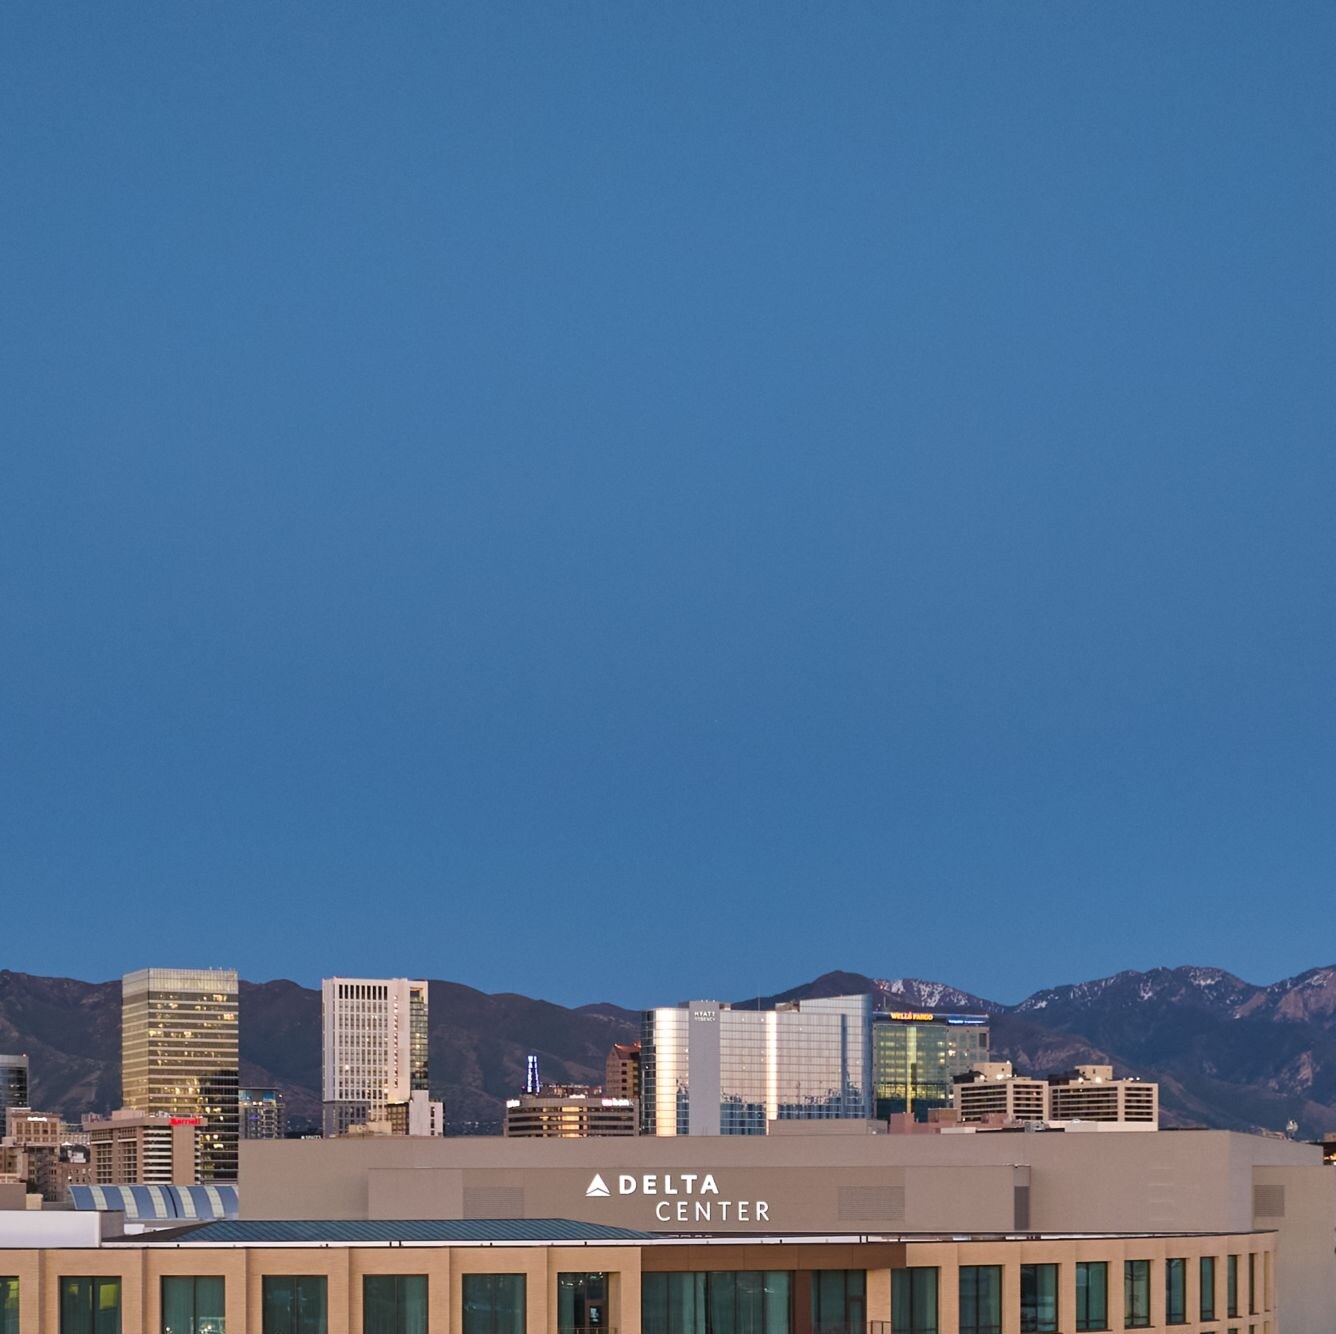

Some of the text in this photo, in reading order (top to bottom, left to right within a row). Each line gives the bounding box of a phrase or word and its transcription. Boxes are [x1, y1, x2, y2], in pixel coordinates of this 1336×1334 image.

[890, 1011, 934, 1021] WELLS FARGO
[618, 1174, 719, 1195] DELTA
[655, 1201, 770, 1222] CENTER
